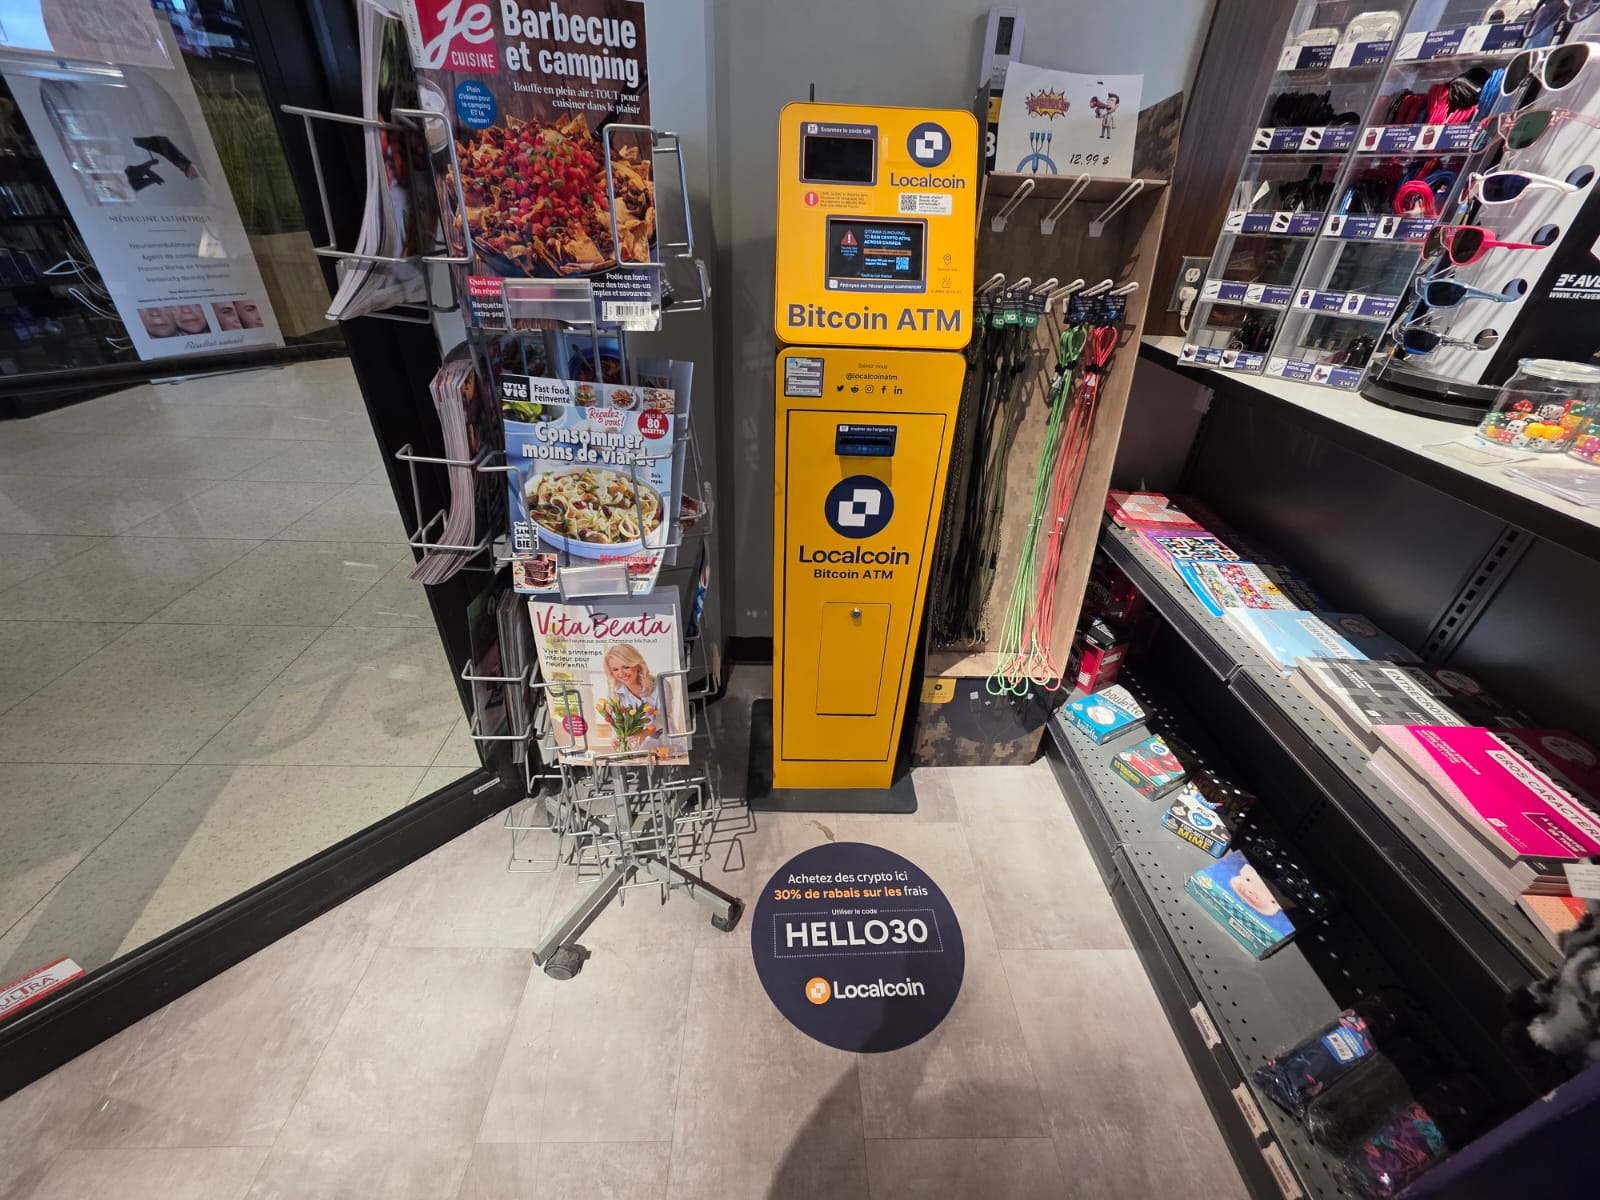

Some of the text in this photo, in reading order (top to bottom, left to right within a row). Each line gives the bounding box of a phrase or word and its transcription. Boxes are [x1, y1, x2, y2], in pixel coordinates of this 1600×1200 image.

[500, 0, 636, 49] Barbecue
[451, 51, 495, 69] CUISINE
[506, 42, 639, 88] et camping
[513, 81, 640, 103] Bouffe en plein air TOUT pour
[552, 99, 641, 115] cuisiner dans le plaisir
[1070, 153, 1100, 165] 12.99
[890, 172, 965, 189] Localcoin
[787, 303, 961, 332] Bitcoin ATM
[846, 372, 898, 381] @localcoinatm
[534, 384, 570, 396] Fast food
[641, 427, 666, 435] RECETTES
[646, 419, 660, 429] 80
[535, 421, 644, 449] Consommer
[522, 440, 656, 467] moins de viande
[799, 545, 910, 565] Localcoin
[813, 568, 894, 580] Bitcoin ATM
[536, 605, 671, 639] Vita Beata
[1494, 752, 1529, 779] GROS
[788, 871, 908, 885] Achetez des crypto ici
[774, 885, 929, 901] 30% de rabais sur les frais
[831, 908, 855, 916] Utiliser
[855, 908, 862, 916] le
[785, 918, 928, 948] HELLO30
[833, 978, 926, 1000] Localcoin
